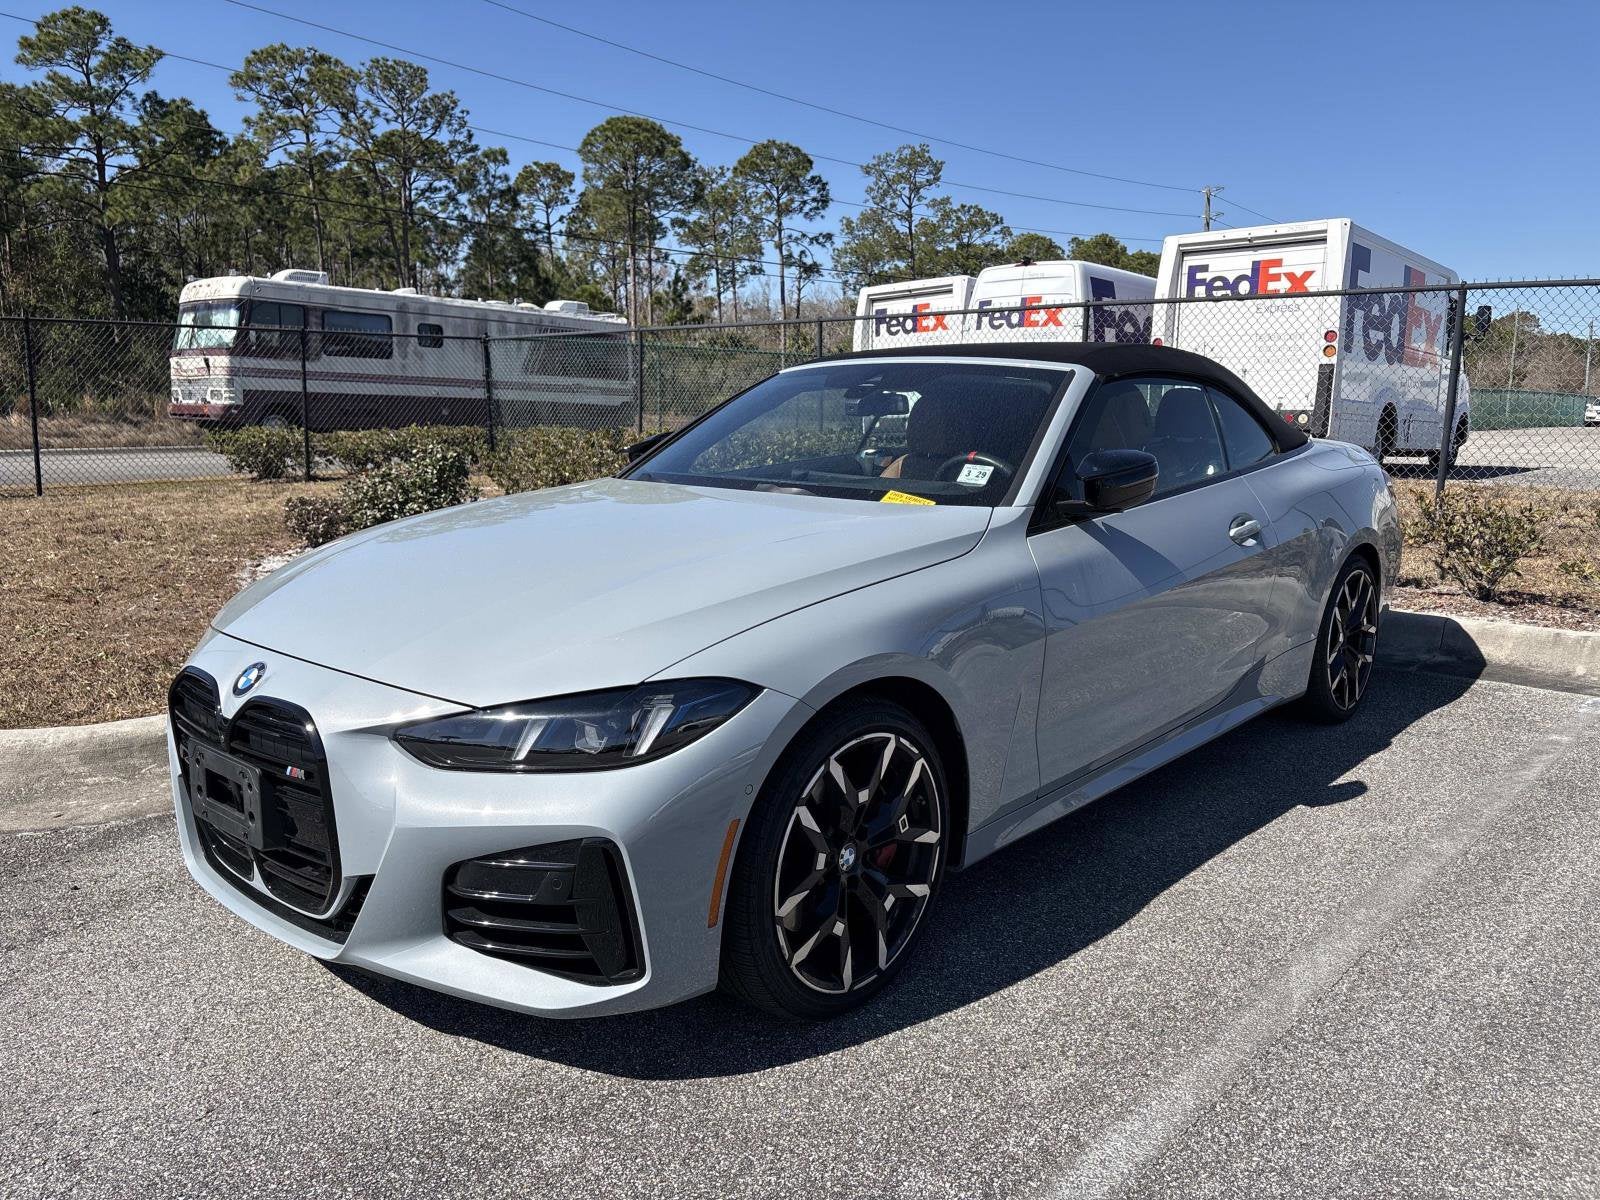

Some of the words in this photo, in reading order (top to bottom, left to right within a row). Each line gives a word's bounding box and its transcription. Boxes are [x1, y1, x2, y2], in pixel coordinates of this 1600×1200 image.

[1186, 258, 1316, 299] FedEx
[875, 303, 949, 337] FedEx
[976, 296, 1064, 330] FedEx
[1343, 242, 1443, 368] FedEx
